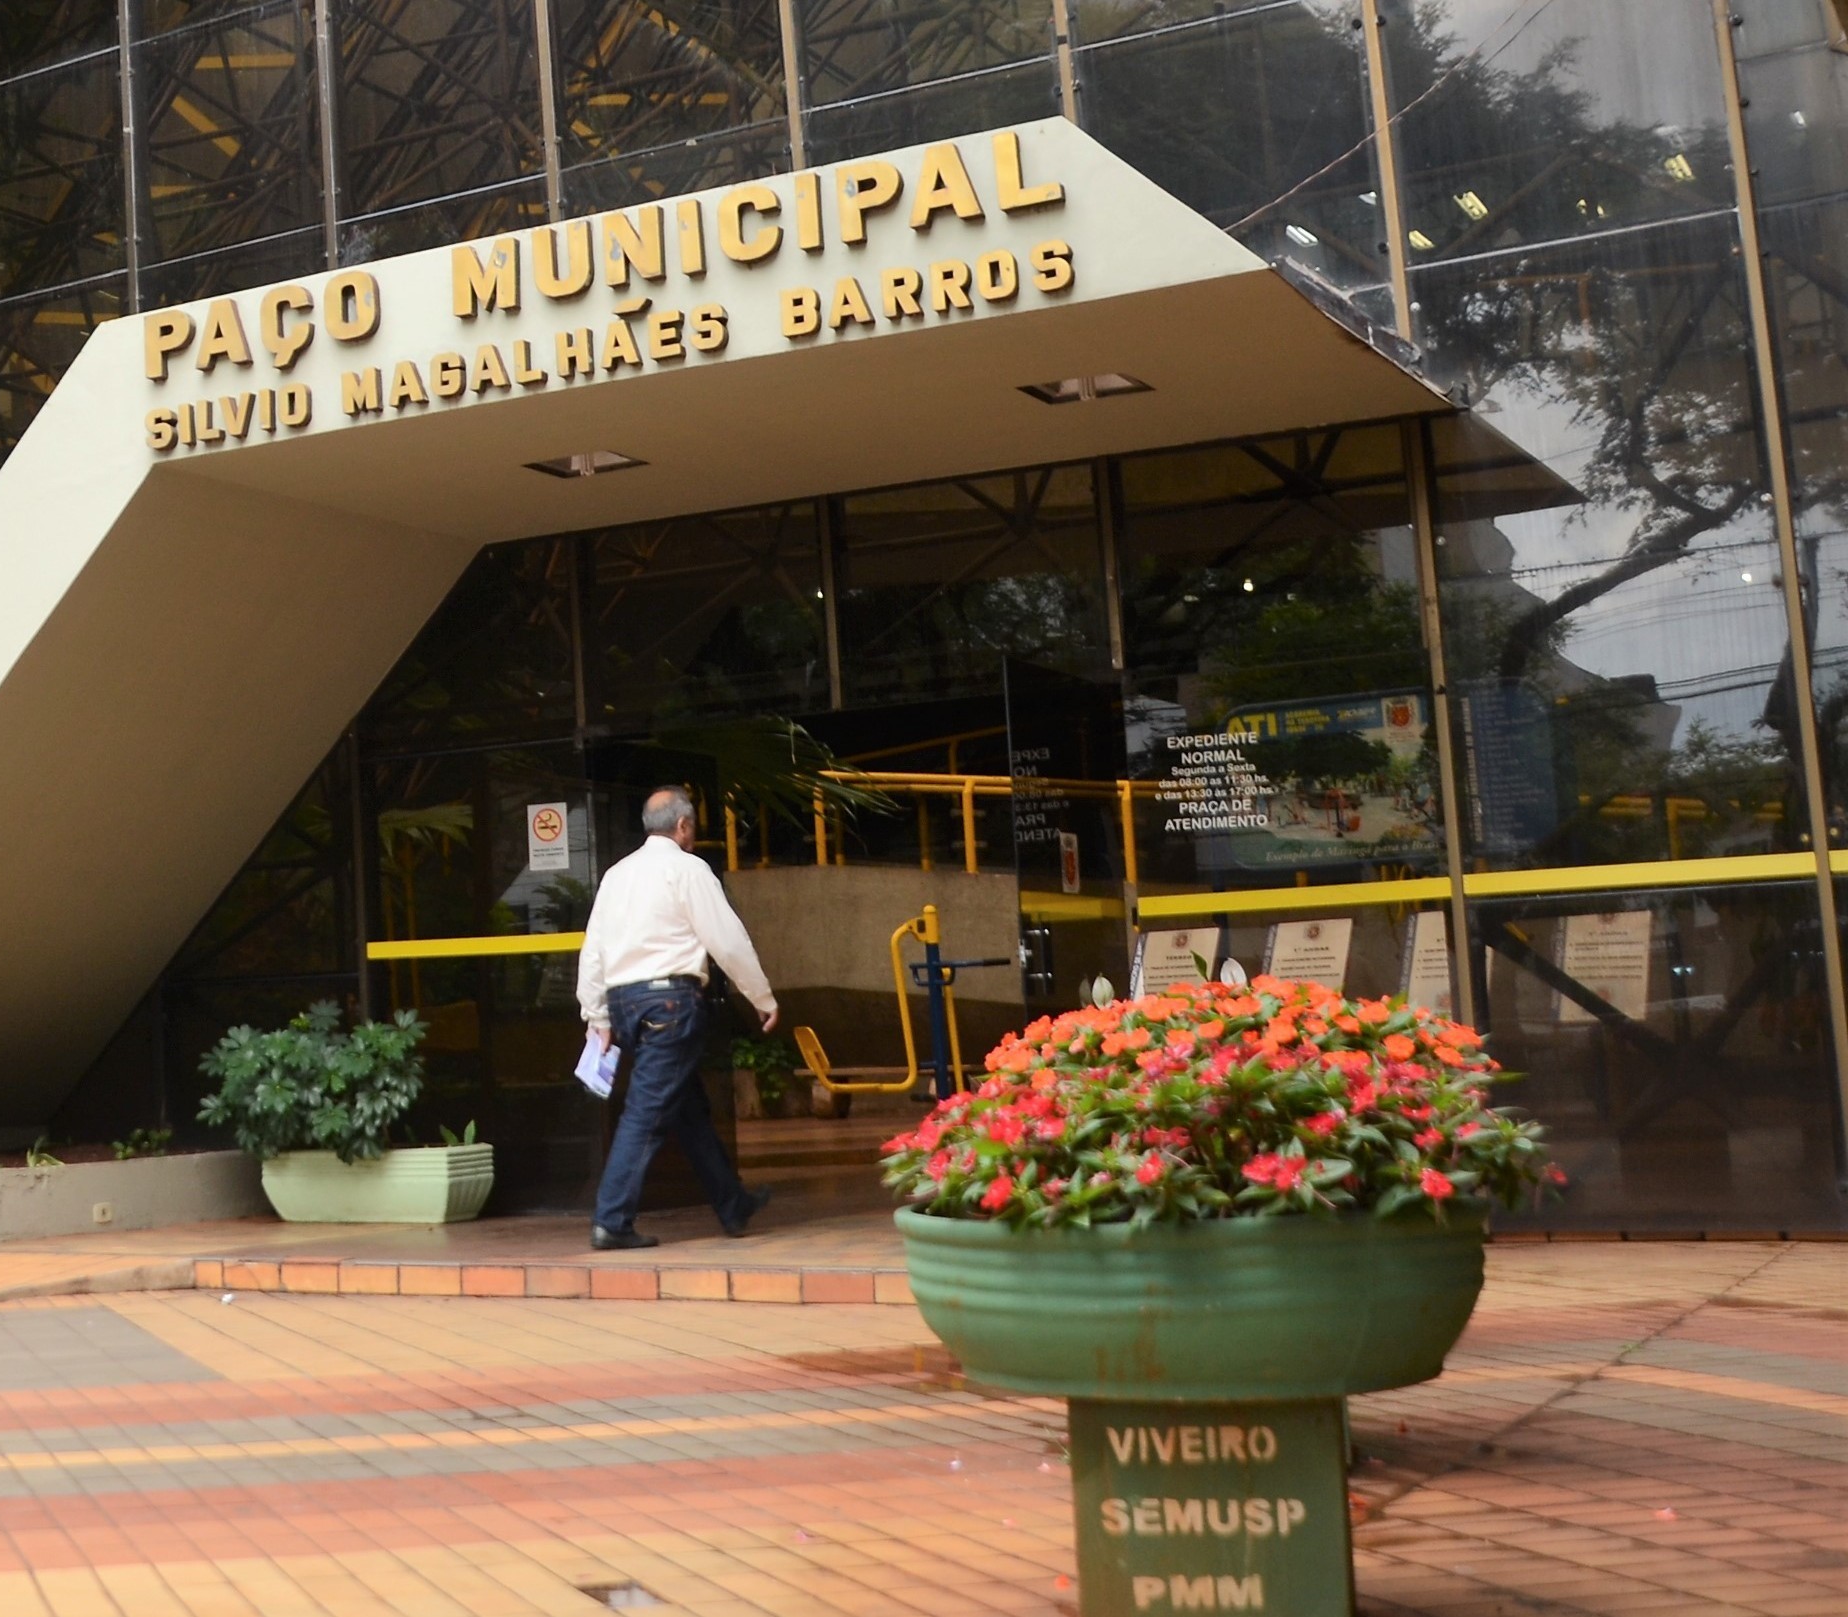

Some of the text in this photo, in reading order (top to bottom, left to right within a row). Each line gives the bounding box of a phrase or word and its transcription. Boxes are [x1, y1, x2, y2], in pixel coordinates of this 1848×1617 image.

[143, 131, 1066, 382] PAÇO MUNICIPAL
[144, 239, 1075, 451] SILVIO MAGALHÃES BARROS
[1226, 712, 1278, 739] ATI
[1166, 731, 1258, 749] EXPEDIENTE
[1181, 749, 1245, 764] NORMAL
[1171, 765, 1216, 777] Segunda
[1226, 763, 1256, 772] Sexta
[1158, 779, 1178, 789] das
[1163, 790, 1182, 800] das
[1184, 788, 1212, 799] 13:30
[1229, 786, 1257, 796] 17:00
[1179, 799, 1252, 815] PRAÇA DE
[1164, 814, 1268, 832] ATENDIMENTO
[1106, 1425, 1278, 1466] VIVEIRO
[1100, 1497, 1307, 1537] SEMUSP
[1132, 1573, 1265, 1610] PMM
